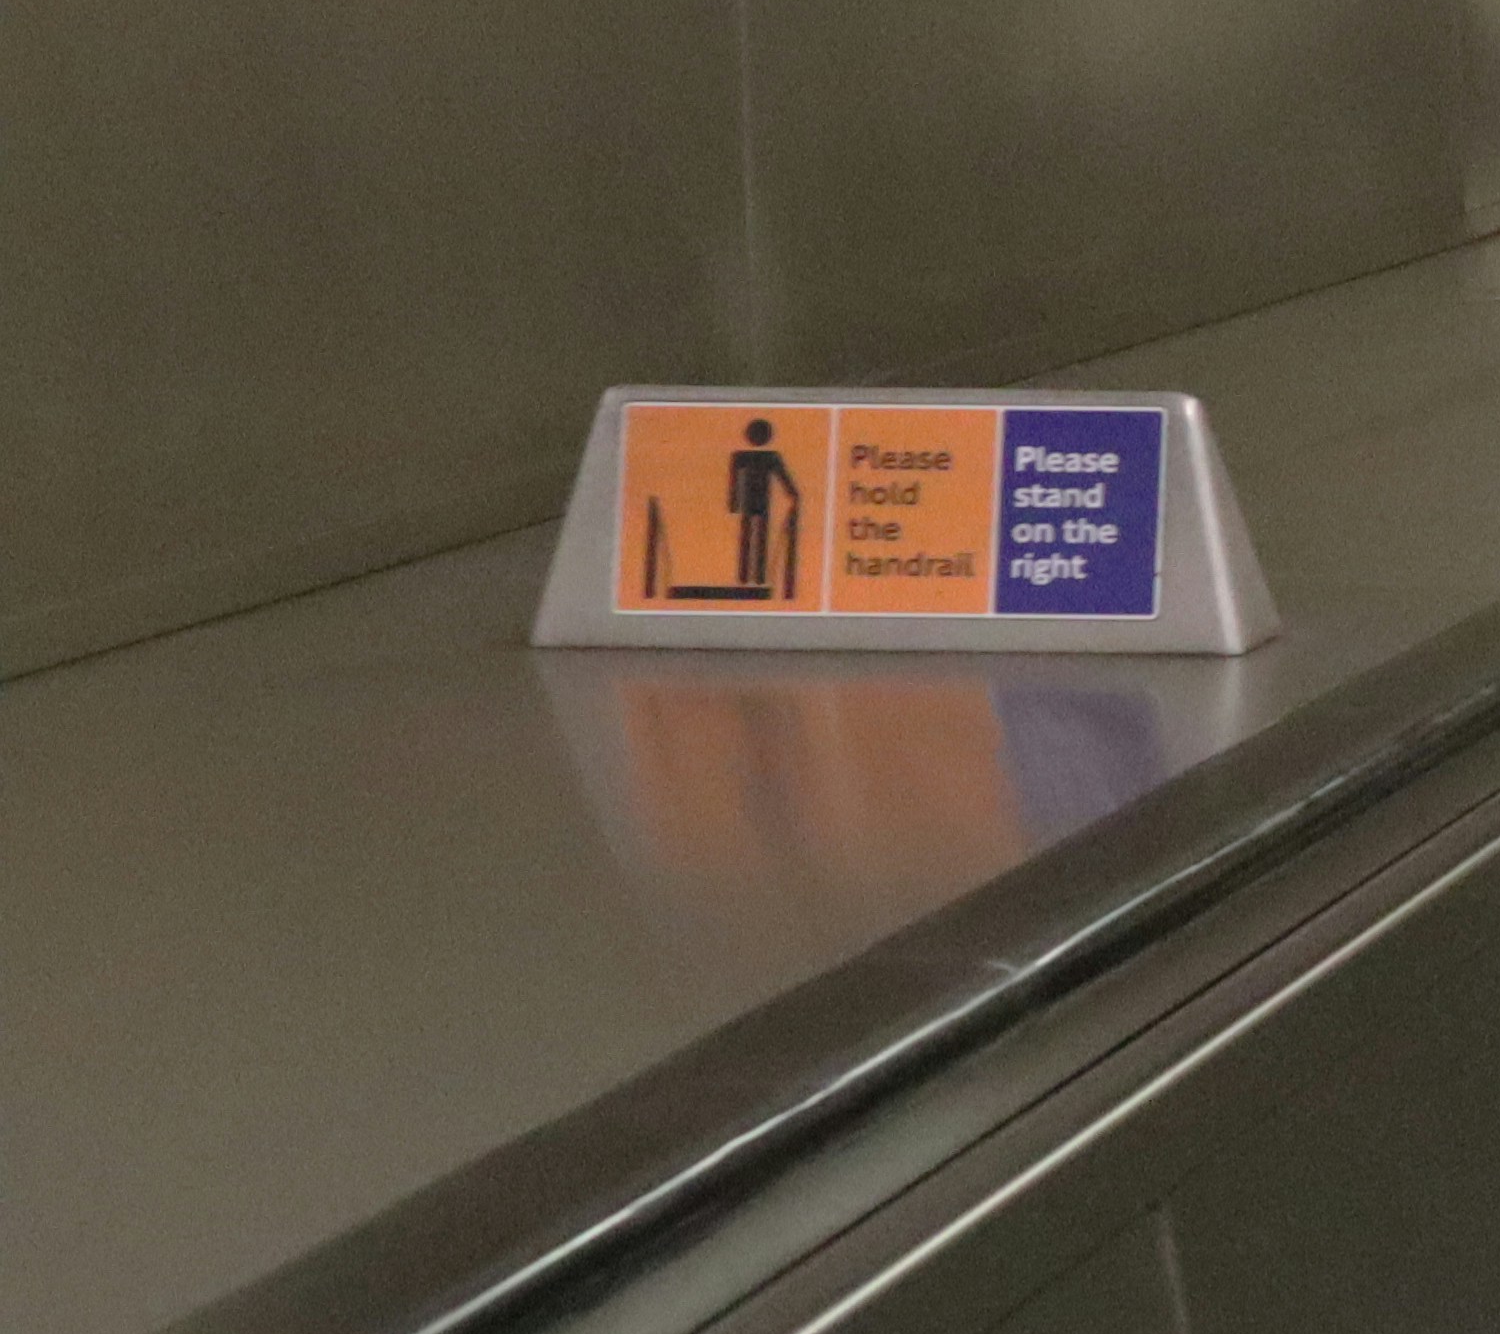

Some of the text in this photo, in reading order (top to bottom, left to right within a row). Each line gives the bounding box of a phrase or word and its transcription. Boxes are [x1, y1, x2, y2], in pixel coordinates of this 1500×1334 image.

[850, 444, 952, 471] Please
[1014, 445, 1120, 475] Please
[849, 480, 920, 506] hold
[1012, 481, 1106, 509] stand
[849, 516, 901, 541] the
[1011, 517, 1119, 545] on the
[845, 551, 978, 579] handrail
[1009, 552, 1087, 586] right
